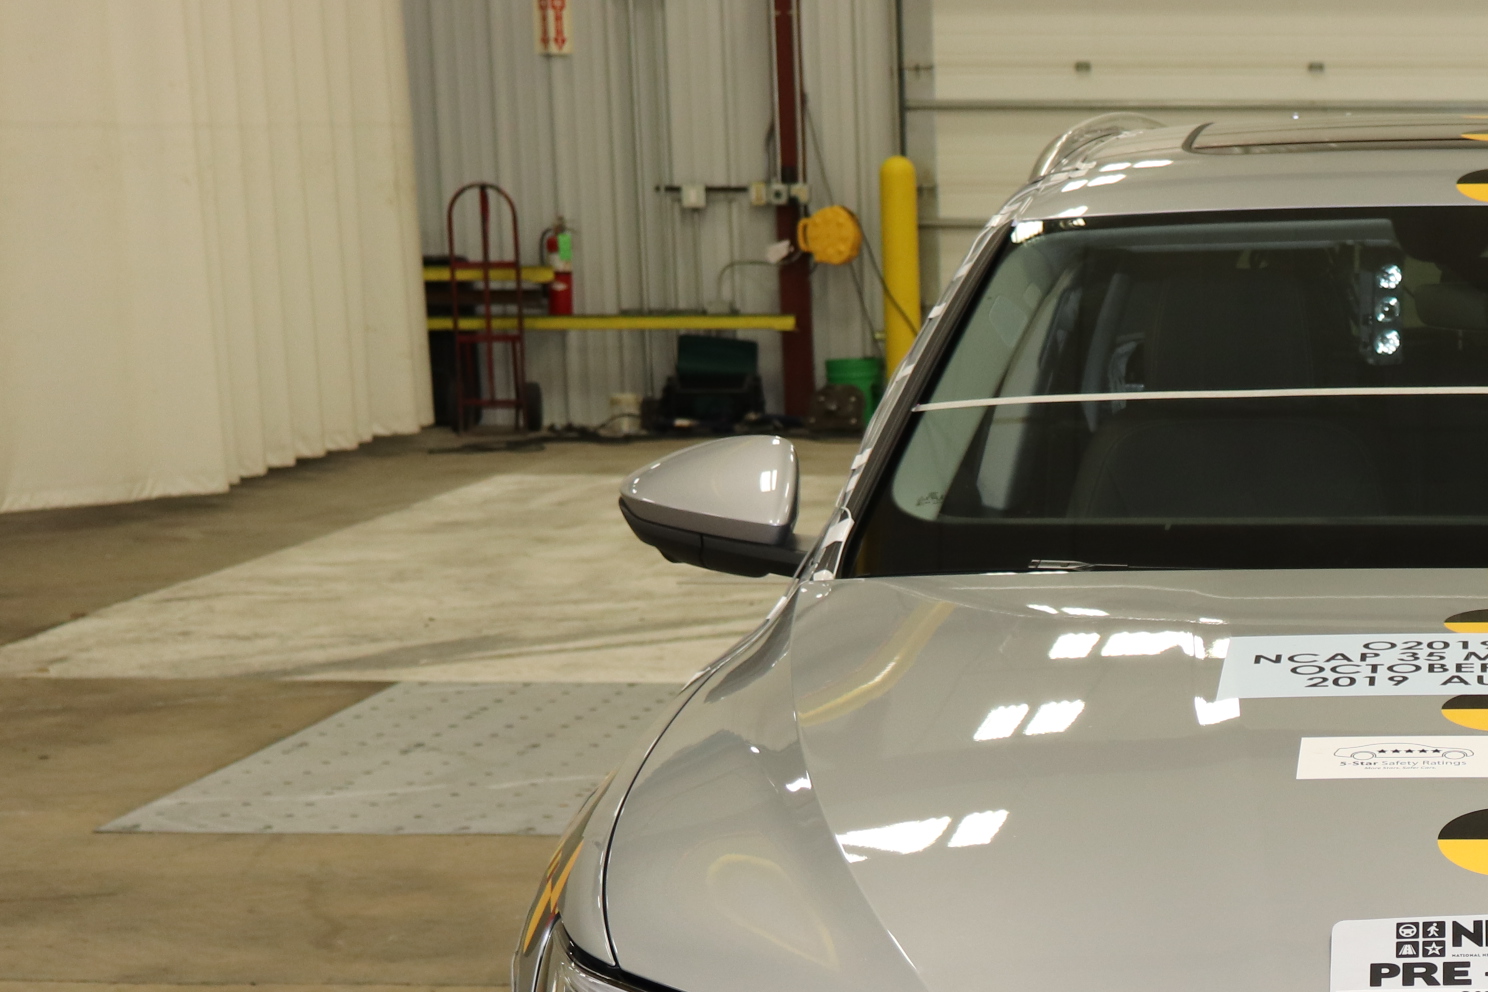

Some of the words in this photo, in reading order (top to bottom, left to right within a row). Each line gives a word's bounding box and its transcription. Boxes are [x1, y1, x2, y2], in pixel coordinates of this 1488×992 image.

[1253, 652, 1381, 664] NCAP
[1397, 652, 1447, 662] 35
[1304, 676, 1409, 688] 2019
[1369, 961, 1472, 987] PRE
